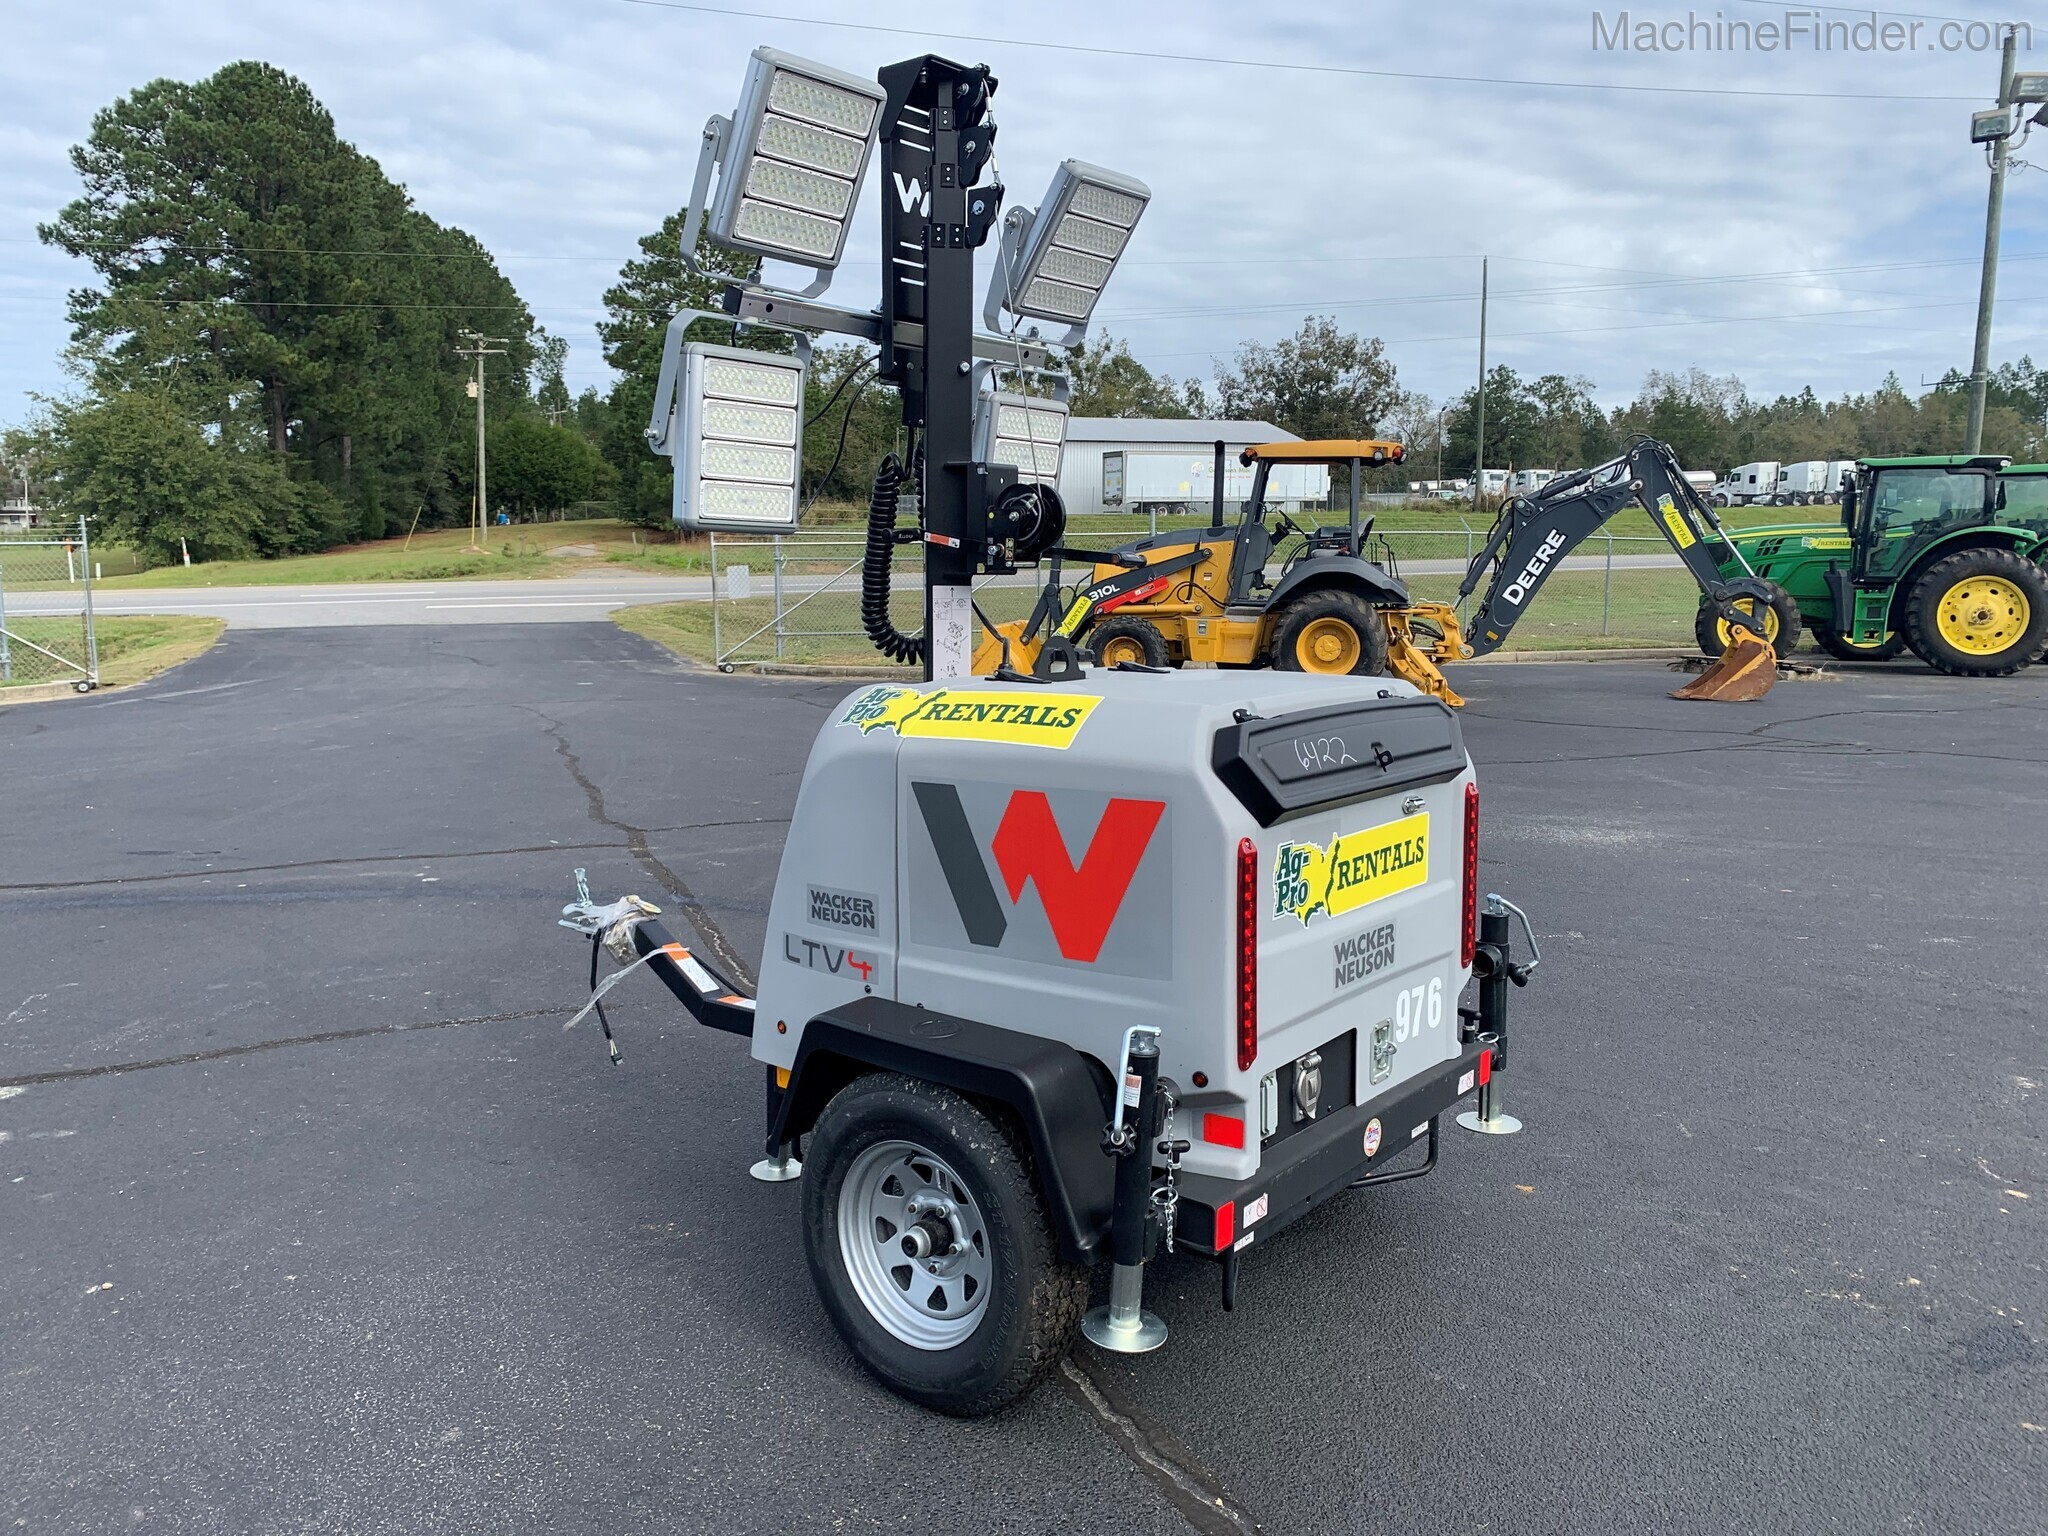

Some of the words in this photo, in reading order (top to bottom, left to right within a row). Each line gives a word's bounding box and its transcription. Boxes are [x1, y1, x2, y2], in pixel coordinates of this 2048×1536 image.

[1669, 513, 1692, 546] RENTALS
[1501, 528, 1567, 607] DEERE
[1088, 583, 1120, 602] 310L
[1067, 598, 1089, 627] RENTALS
[842, 703, 889, 723] Pro
[857, 688, 906, 705] Ag-
[920, 703, 1083, 729] RENTALS
[1294, 736, 1358, 770] 6422
[1277, 846, 1310, 881] Ag-
[1337, 836, 1425, 890] RENTALS
[810, 889, 874, 914] WACKER
[1276, 880, 1310, 914] Pro
[811, 905, 876, 929] NEUSON
[785, 934, 873, 981] LTV4
[1334, 923, 1395, 965] WACKER
[1334, 944, 1395, 989] NEUSON
[1395, 976, 1442, 1043] 976
